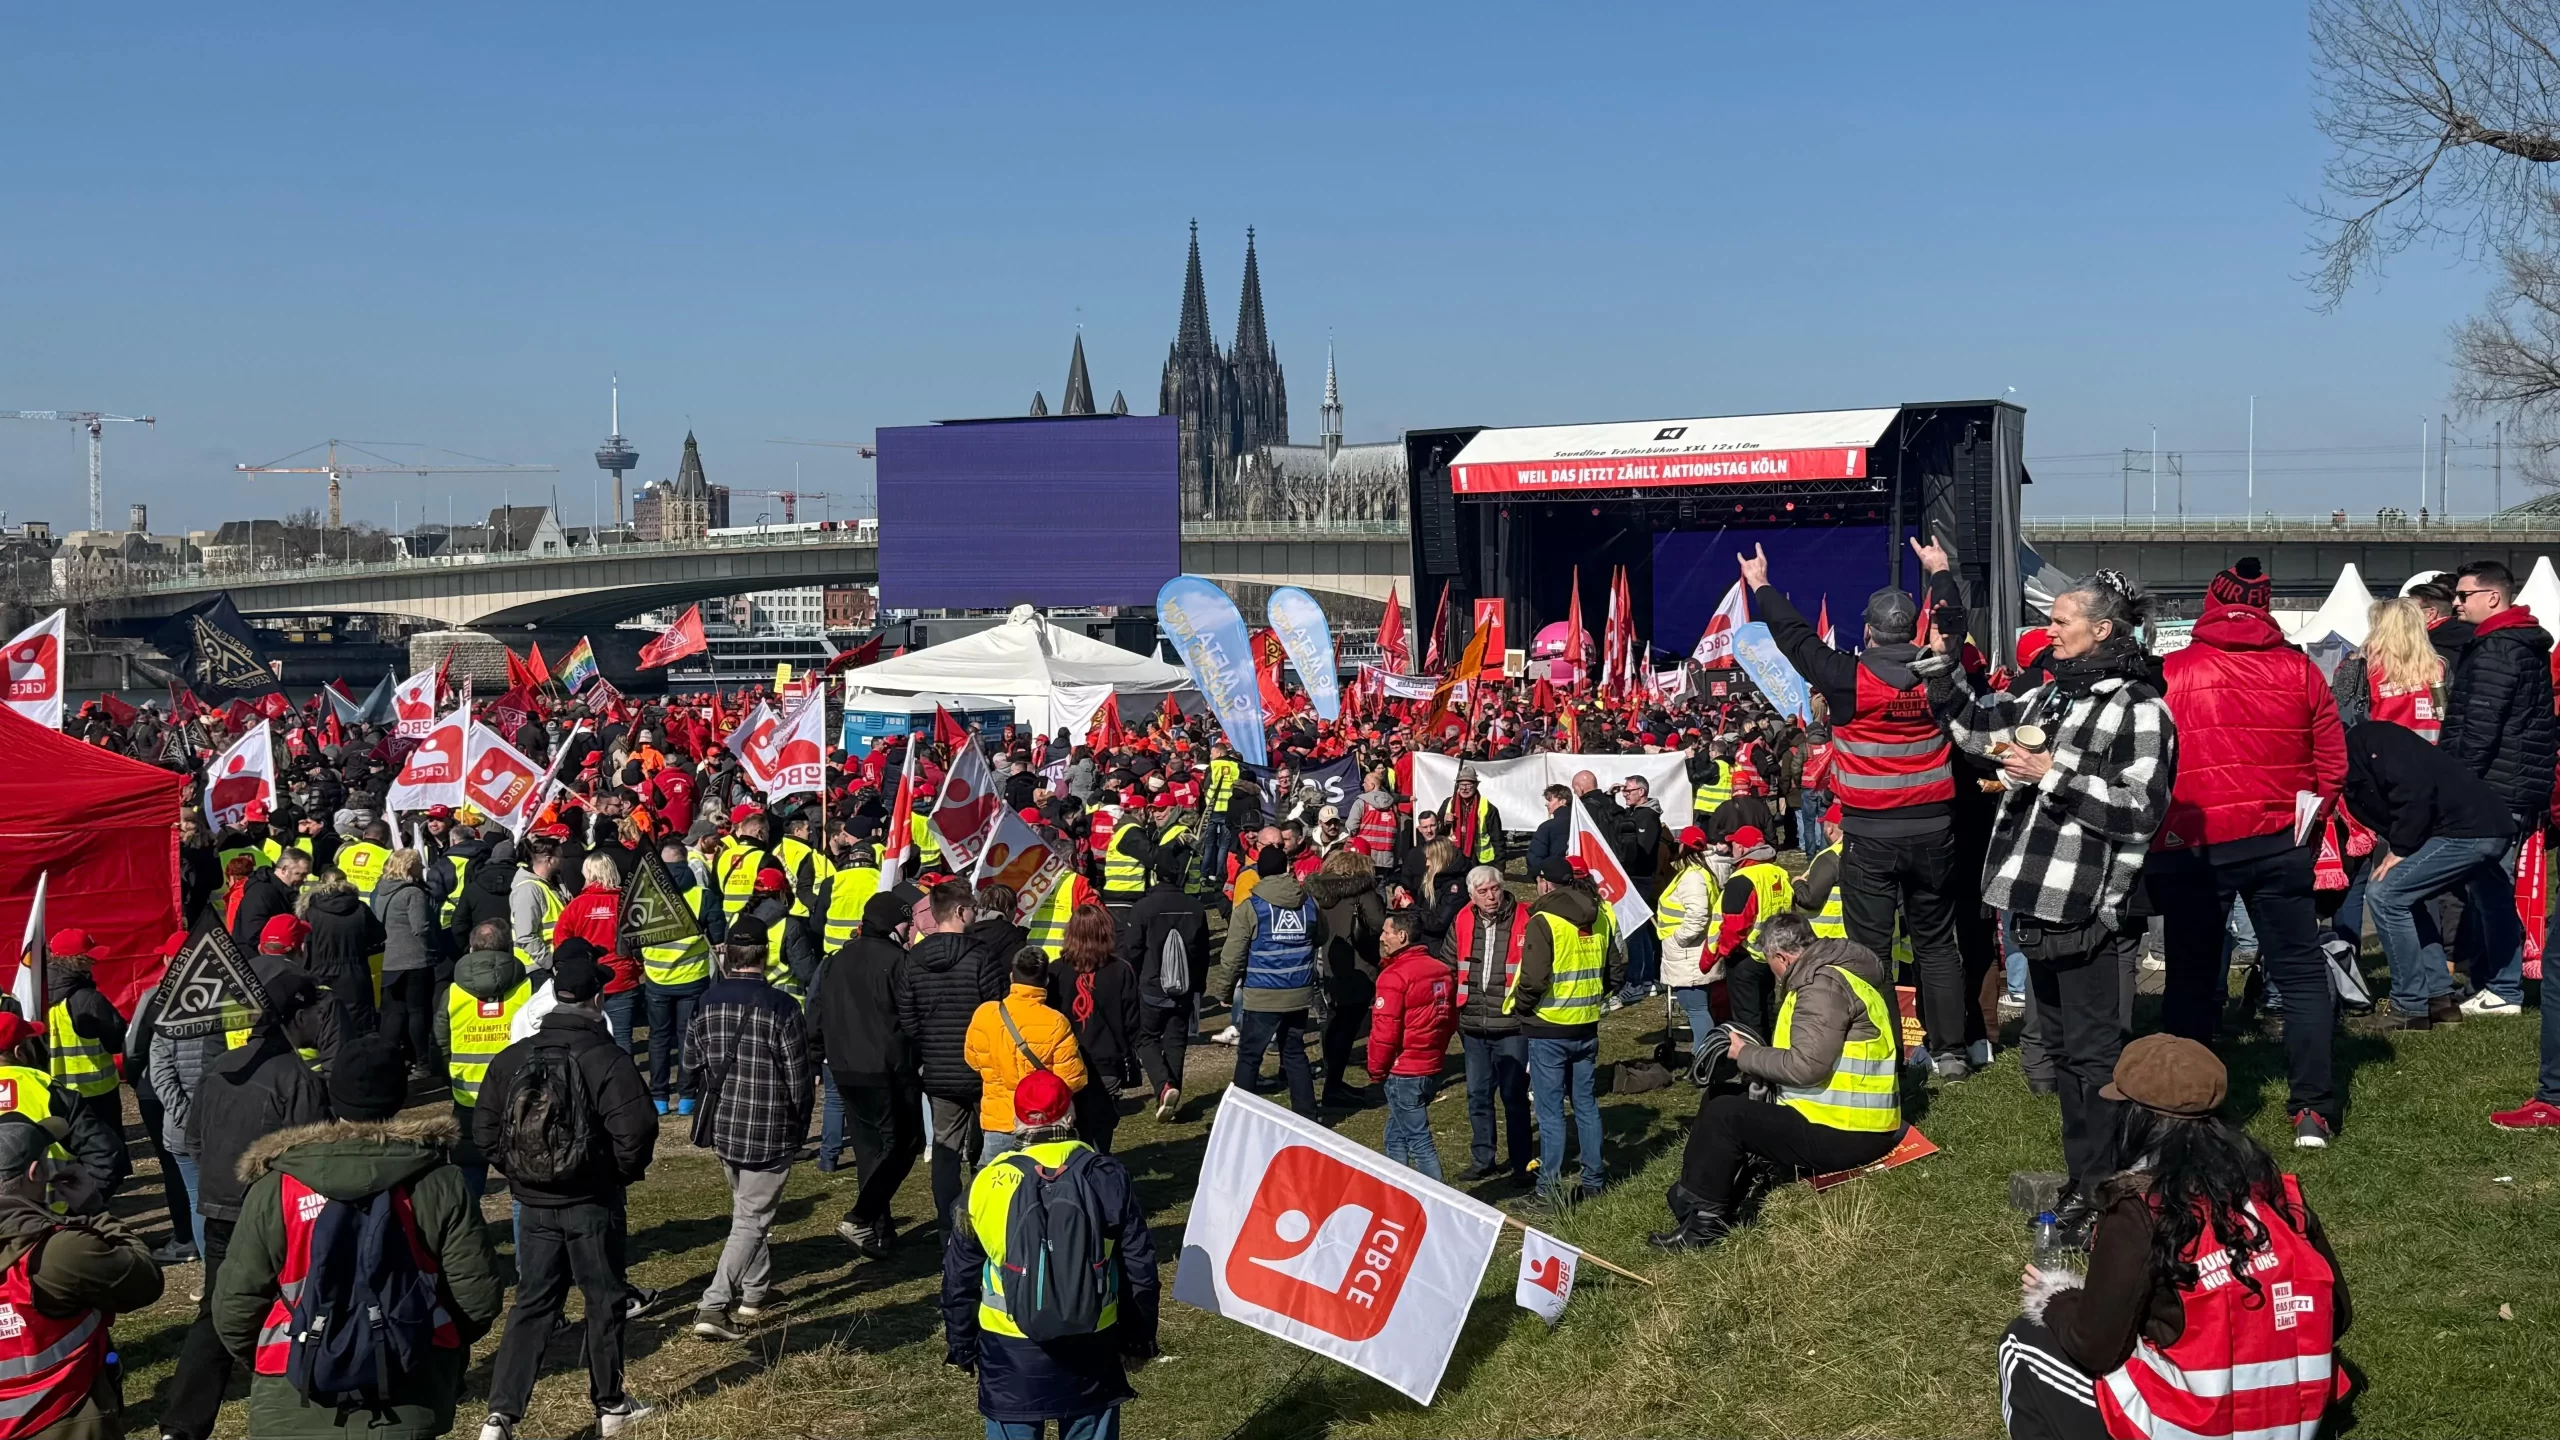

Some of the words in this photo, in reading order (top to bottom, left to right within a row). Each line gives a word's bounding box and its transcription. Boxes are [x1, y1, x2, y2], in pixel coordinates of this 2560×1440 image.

[1553, 448, 1607, 458] Soundline
[1611, 446, 1679, 455] Trailerbühne
[1518, 470, 1548, 484] WEIL
[1551, 468, 1576, 482] DAS
[1578, 467, 1615, 484] JETZT
[1617, 463, 1659, 480] ZÄHLT.
[1662, 461, 1747, 478] AKTIONSTAG
[1750, 456, 1788, 474] KÖLN
[2213, 574, 2243, 604] WIR
[1346, 1217, 1406, 1310] IGBCE
[2201, 1268, 2232, 1291] NUR
[2254, 1252, 2280, 1272] UNS
[1556, 1261, 1571, 1302] IGBCE
[2277, 1315, 2295, 1327] ZÄHLT
